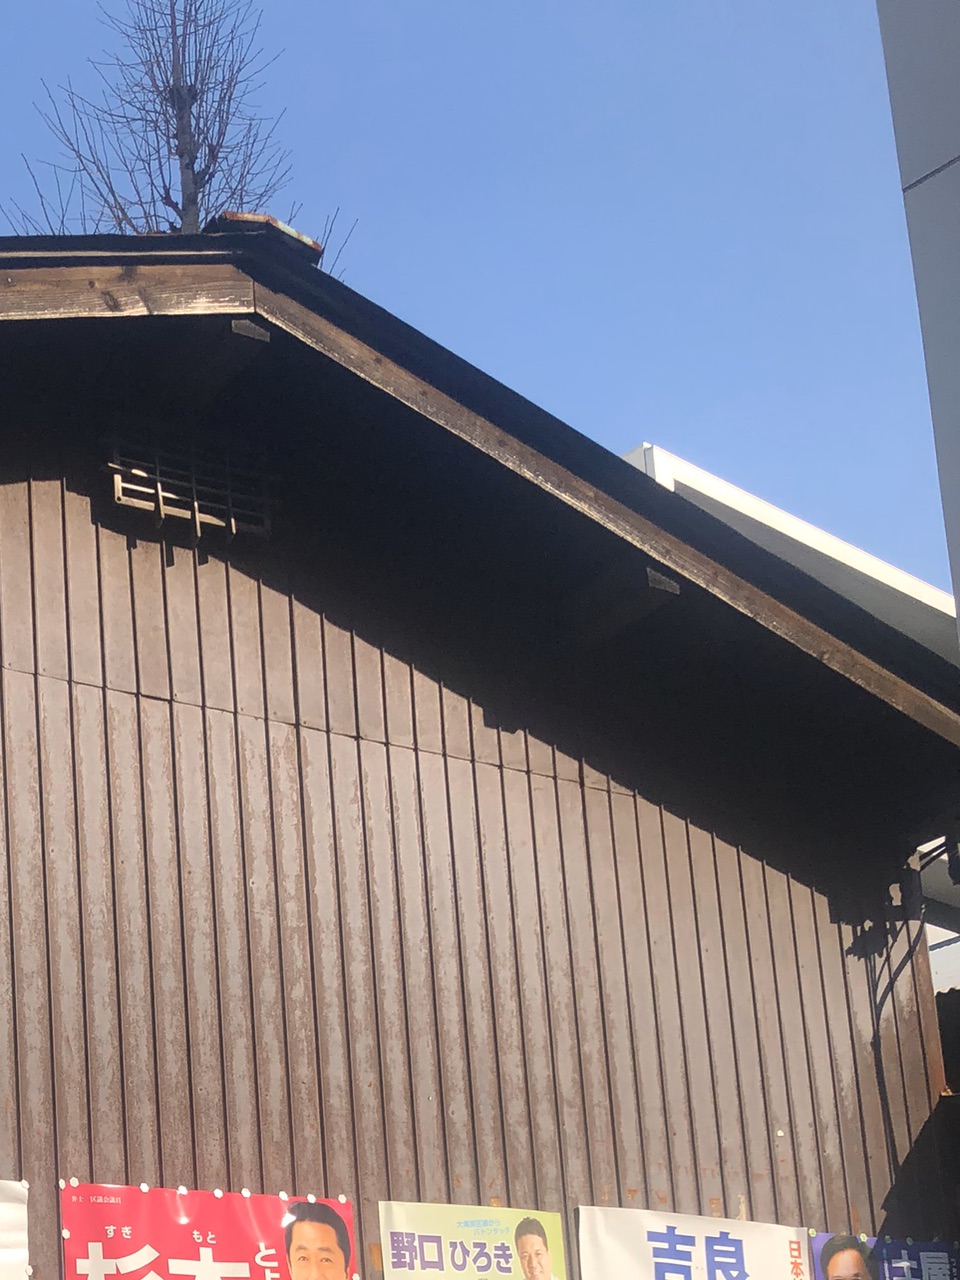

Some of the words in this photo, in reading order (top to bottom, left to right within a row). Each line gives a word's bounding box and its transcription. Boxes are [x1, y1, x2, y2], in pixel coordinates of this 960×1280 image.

[104, 1225, 132, 1239] すぎ
[192, 1230, 217, 1244] もと
[390, 1231, 444, 1272] 野口
[449, 1240, 513, 1274] ひろき
